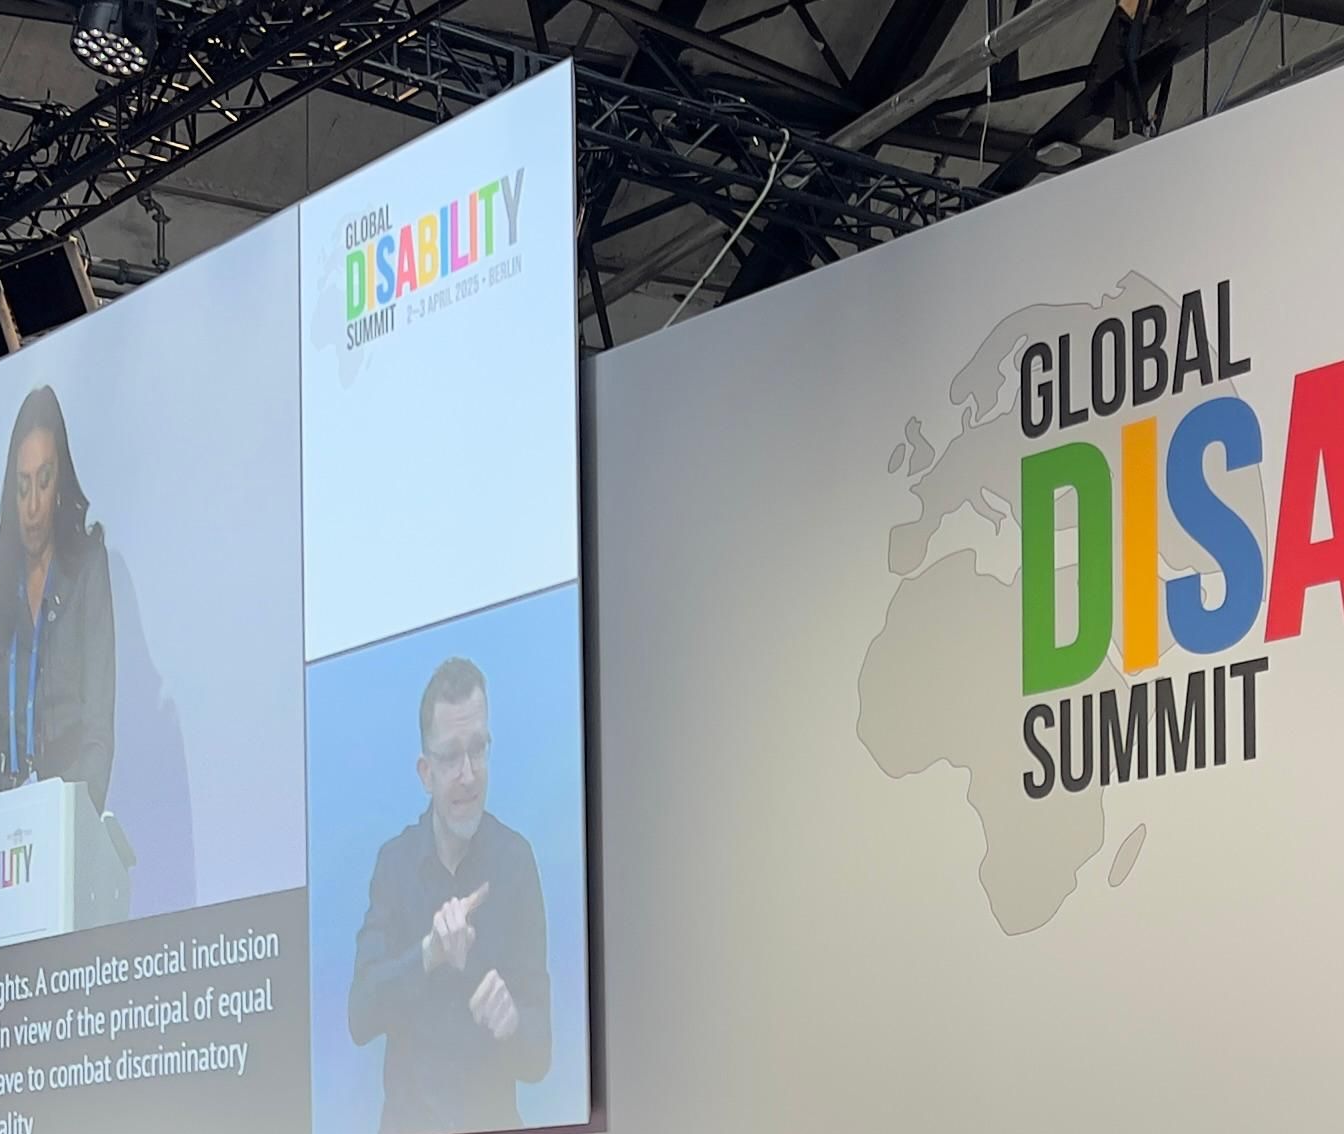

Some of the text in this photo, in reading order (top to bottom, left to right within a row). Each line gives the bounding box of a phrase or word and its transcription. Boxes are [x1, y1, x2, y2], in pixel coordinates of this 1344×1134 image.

[346, 203, 393, 250] GLOBAL
[346, 167, 525, 322] DISABILITY
[428, 286, 454, 316] APRIL
[456, 272, 480, 302] 2025
[489, 253, 522, 288] BERLIN
[347, 303, 397, 351] SUMMIT
[1020, 279, 1251, 439] GLOBAL
[1022, 656, 1269, 799] SUMMIT
[35, 968, 49, 996] A
[50, 956, 129, 994] complete
[134, 942, 186, 979] social
[192, 929, 278, 969] inclusion
[14, 1017, 52, 1045] view
[56, 1009, 75, 1040] of
[77, 1007, 104, 1035] the
[110, 992, 189, 1039] principal
[194, 987, 214, 1019] of
[218, 979, 273, 1022] equal
[28, 1066, 44, 1091] to
[49, 1055, 111, 1088] combat
[116, 1042, 248, 1080] discriminatory
